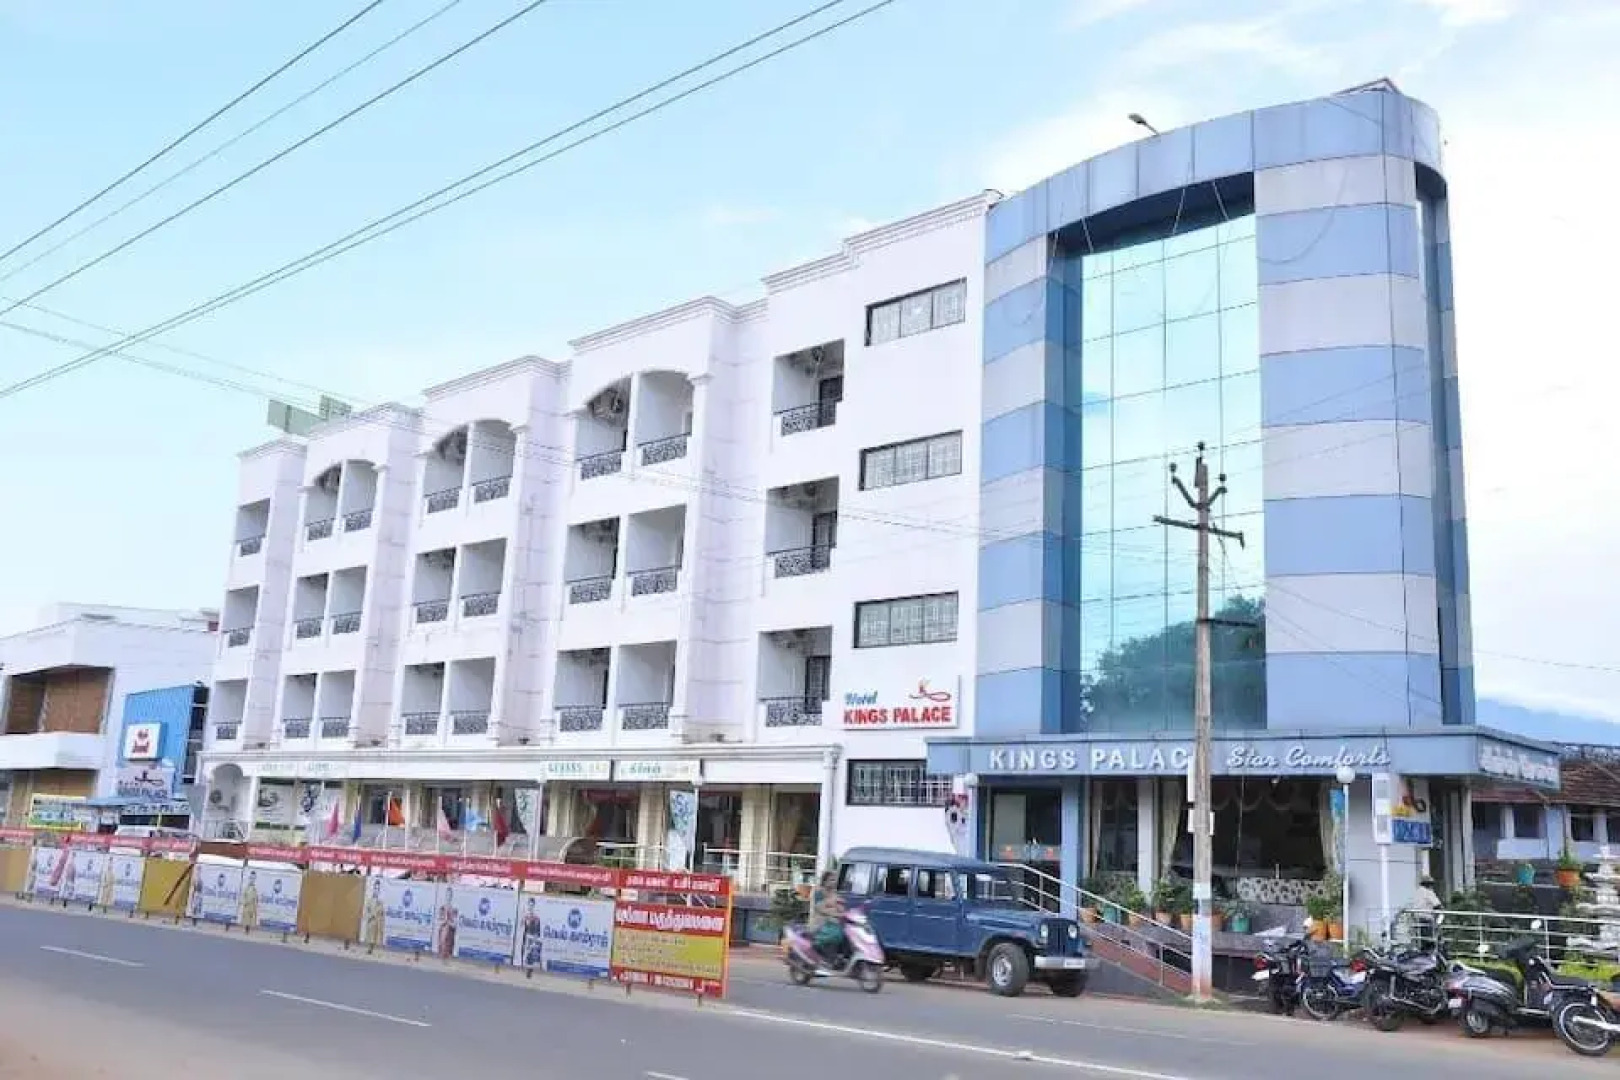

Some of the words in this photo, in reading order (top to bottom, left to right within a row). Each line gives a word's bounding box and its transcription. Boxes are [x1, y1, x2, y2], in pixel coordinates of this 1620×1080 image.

[843, 708, 888, 724] KINGS
[893, 706, 952, 722] PALACE
[989, 748, 1077, 770] KINGS
[1091, 747, 1191, 770] PALAC
[1226, 746, 1279, 768] Star
[1285, 744, 1391, 769] Comforts
